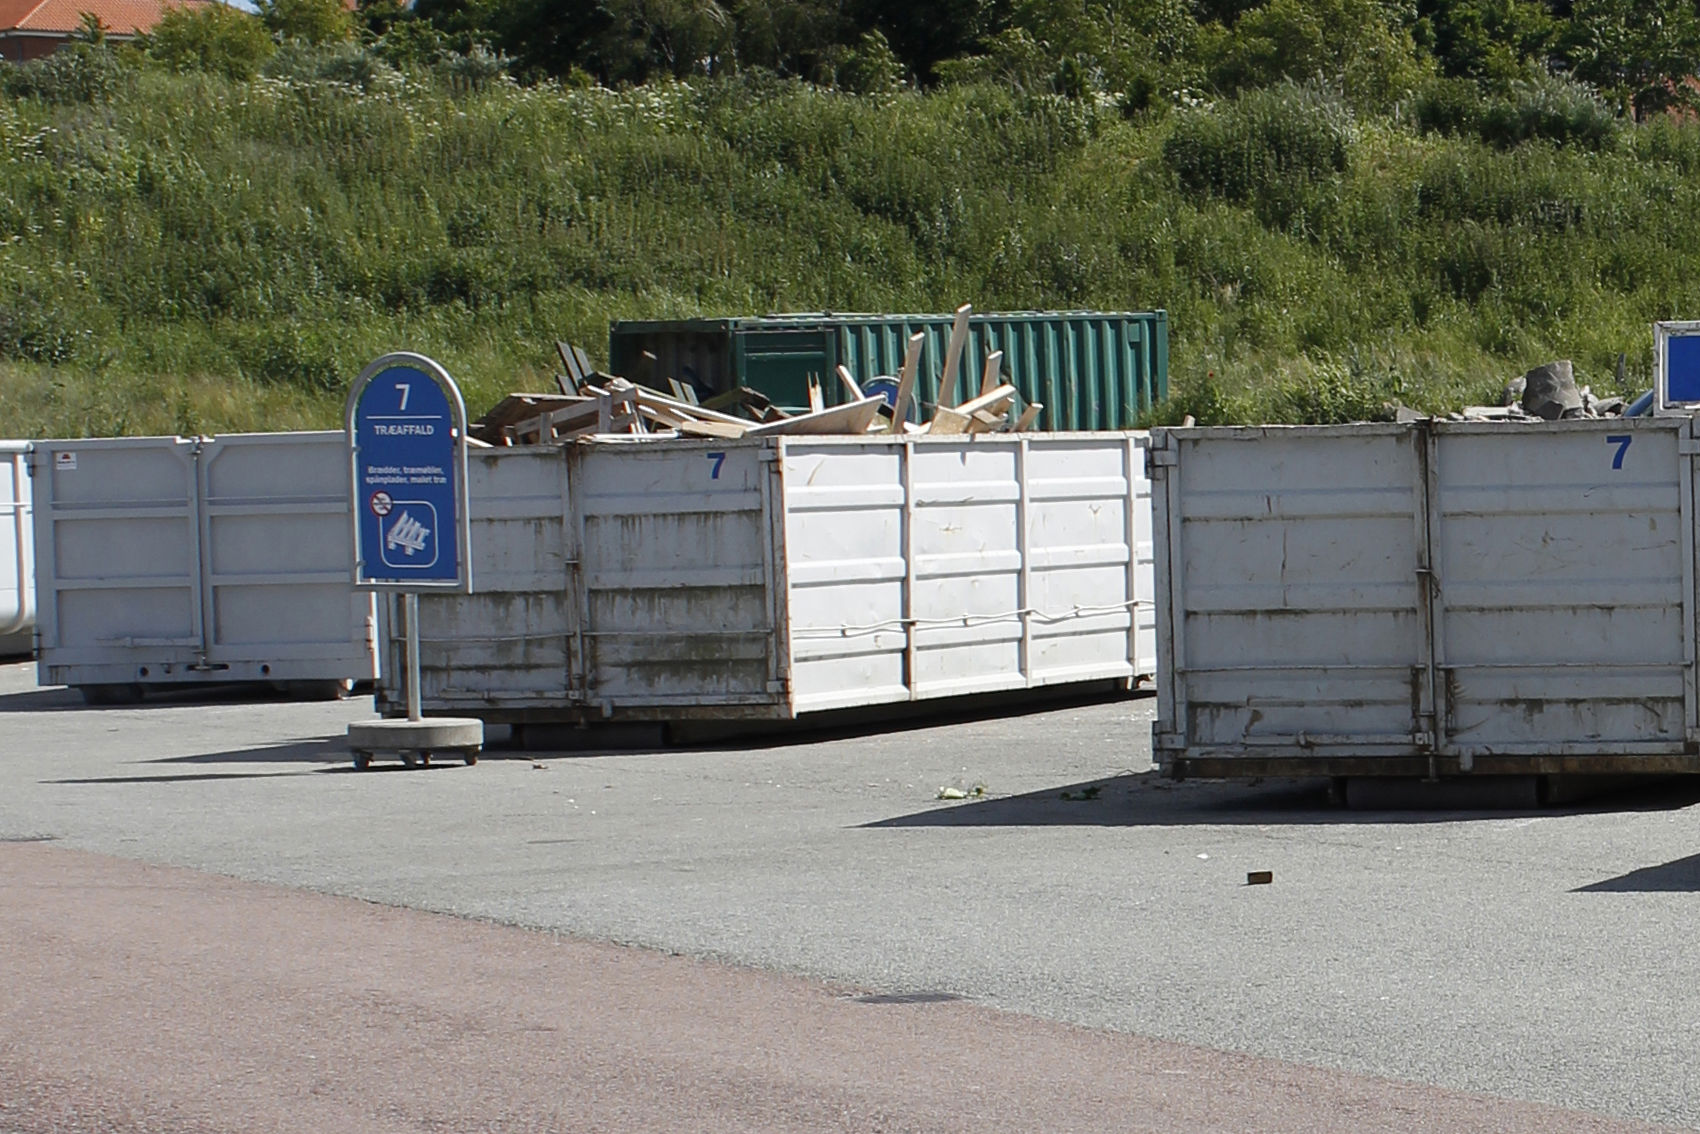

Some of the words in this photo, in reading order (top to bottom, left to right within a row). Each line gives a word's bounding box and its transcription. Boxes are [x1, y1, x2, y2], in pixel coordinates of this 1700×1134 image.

[395, 383, 410, 411] 7
[373, 424, 434, 436] TRÆAFFALD
[706, 452, 726, 480] 7
[1606, 434, 1632, 470] 7
